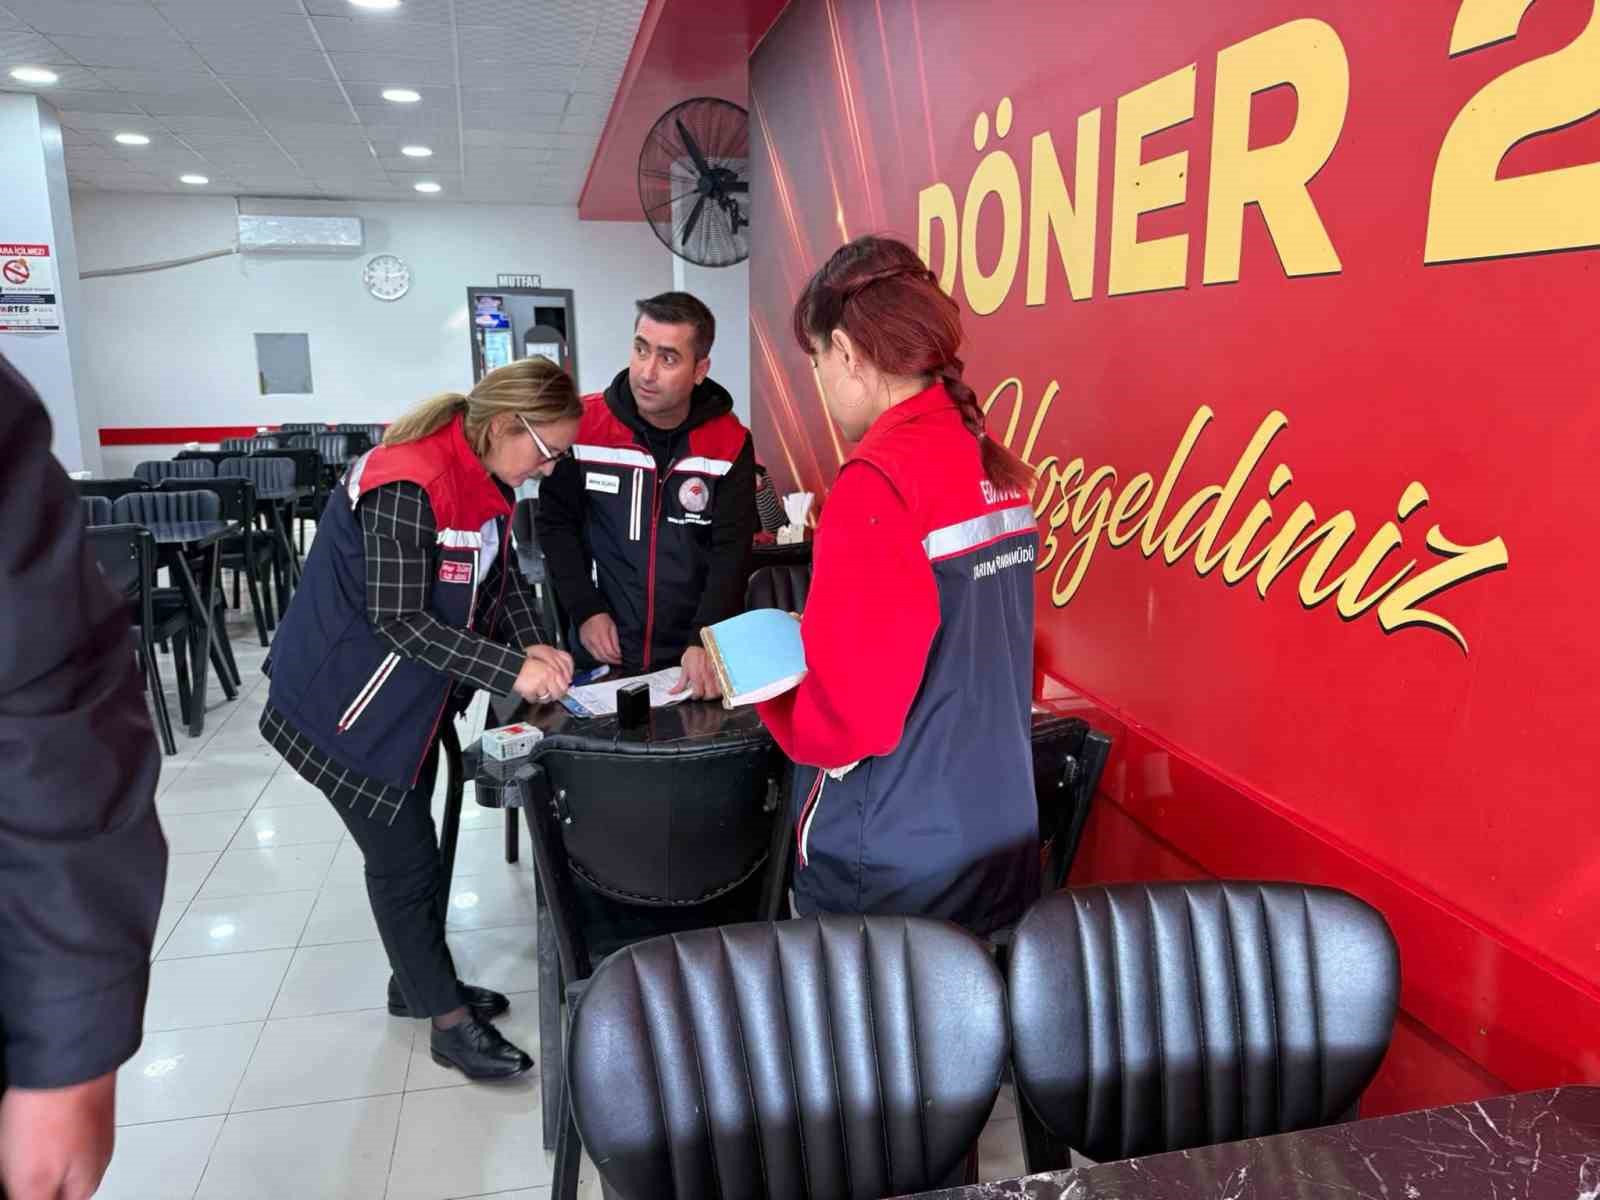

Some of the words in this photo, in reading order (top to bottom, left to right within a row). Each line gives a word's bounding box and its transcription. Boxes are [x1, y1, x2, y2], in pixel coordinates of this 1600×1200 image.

[918, 17, 1350, 316] DÖNER
[0, 304, 30, 313] ARTES
[498, 275, 539, 287] MUTFAK
[982, 377, 1509, 656] Hoşgeldiniz
